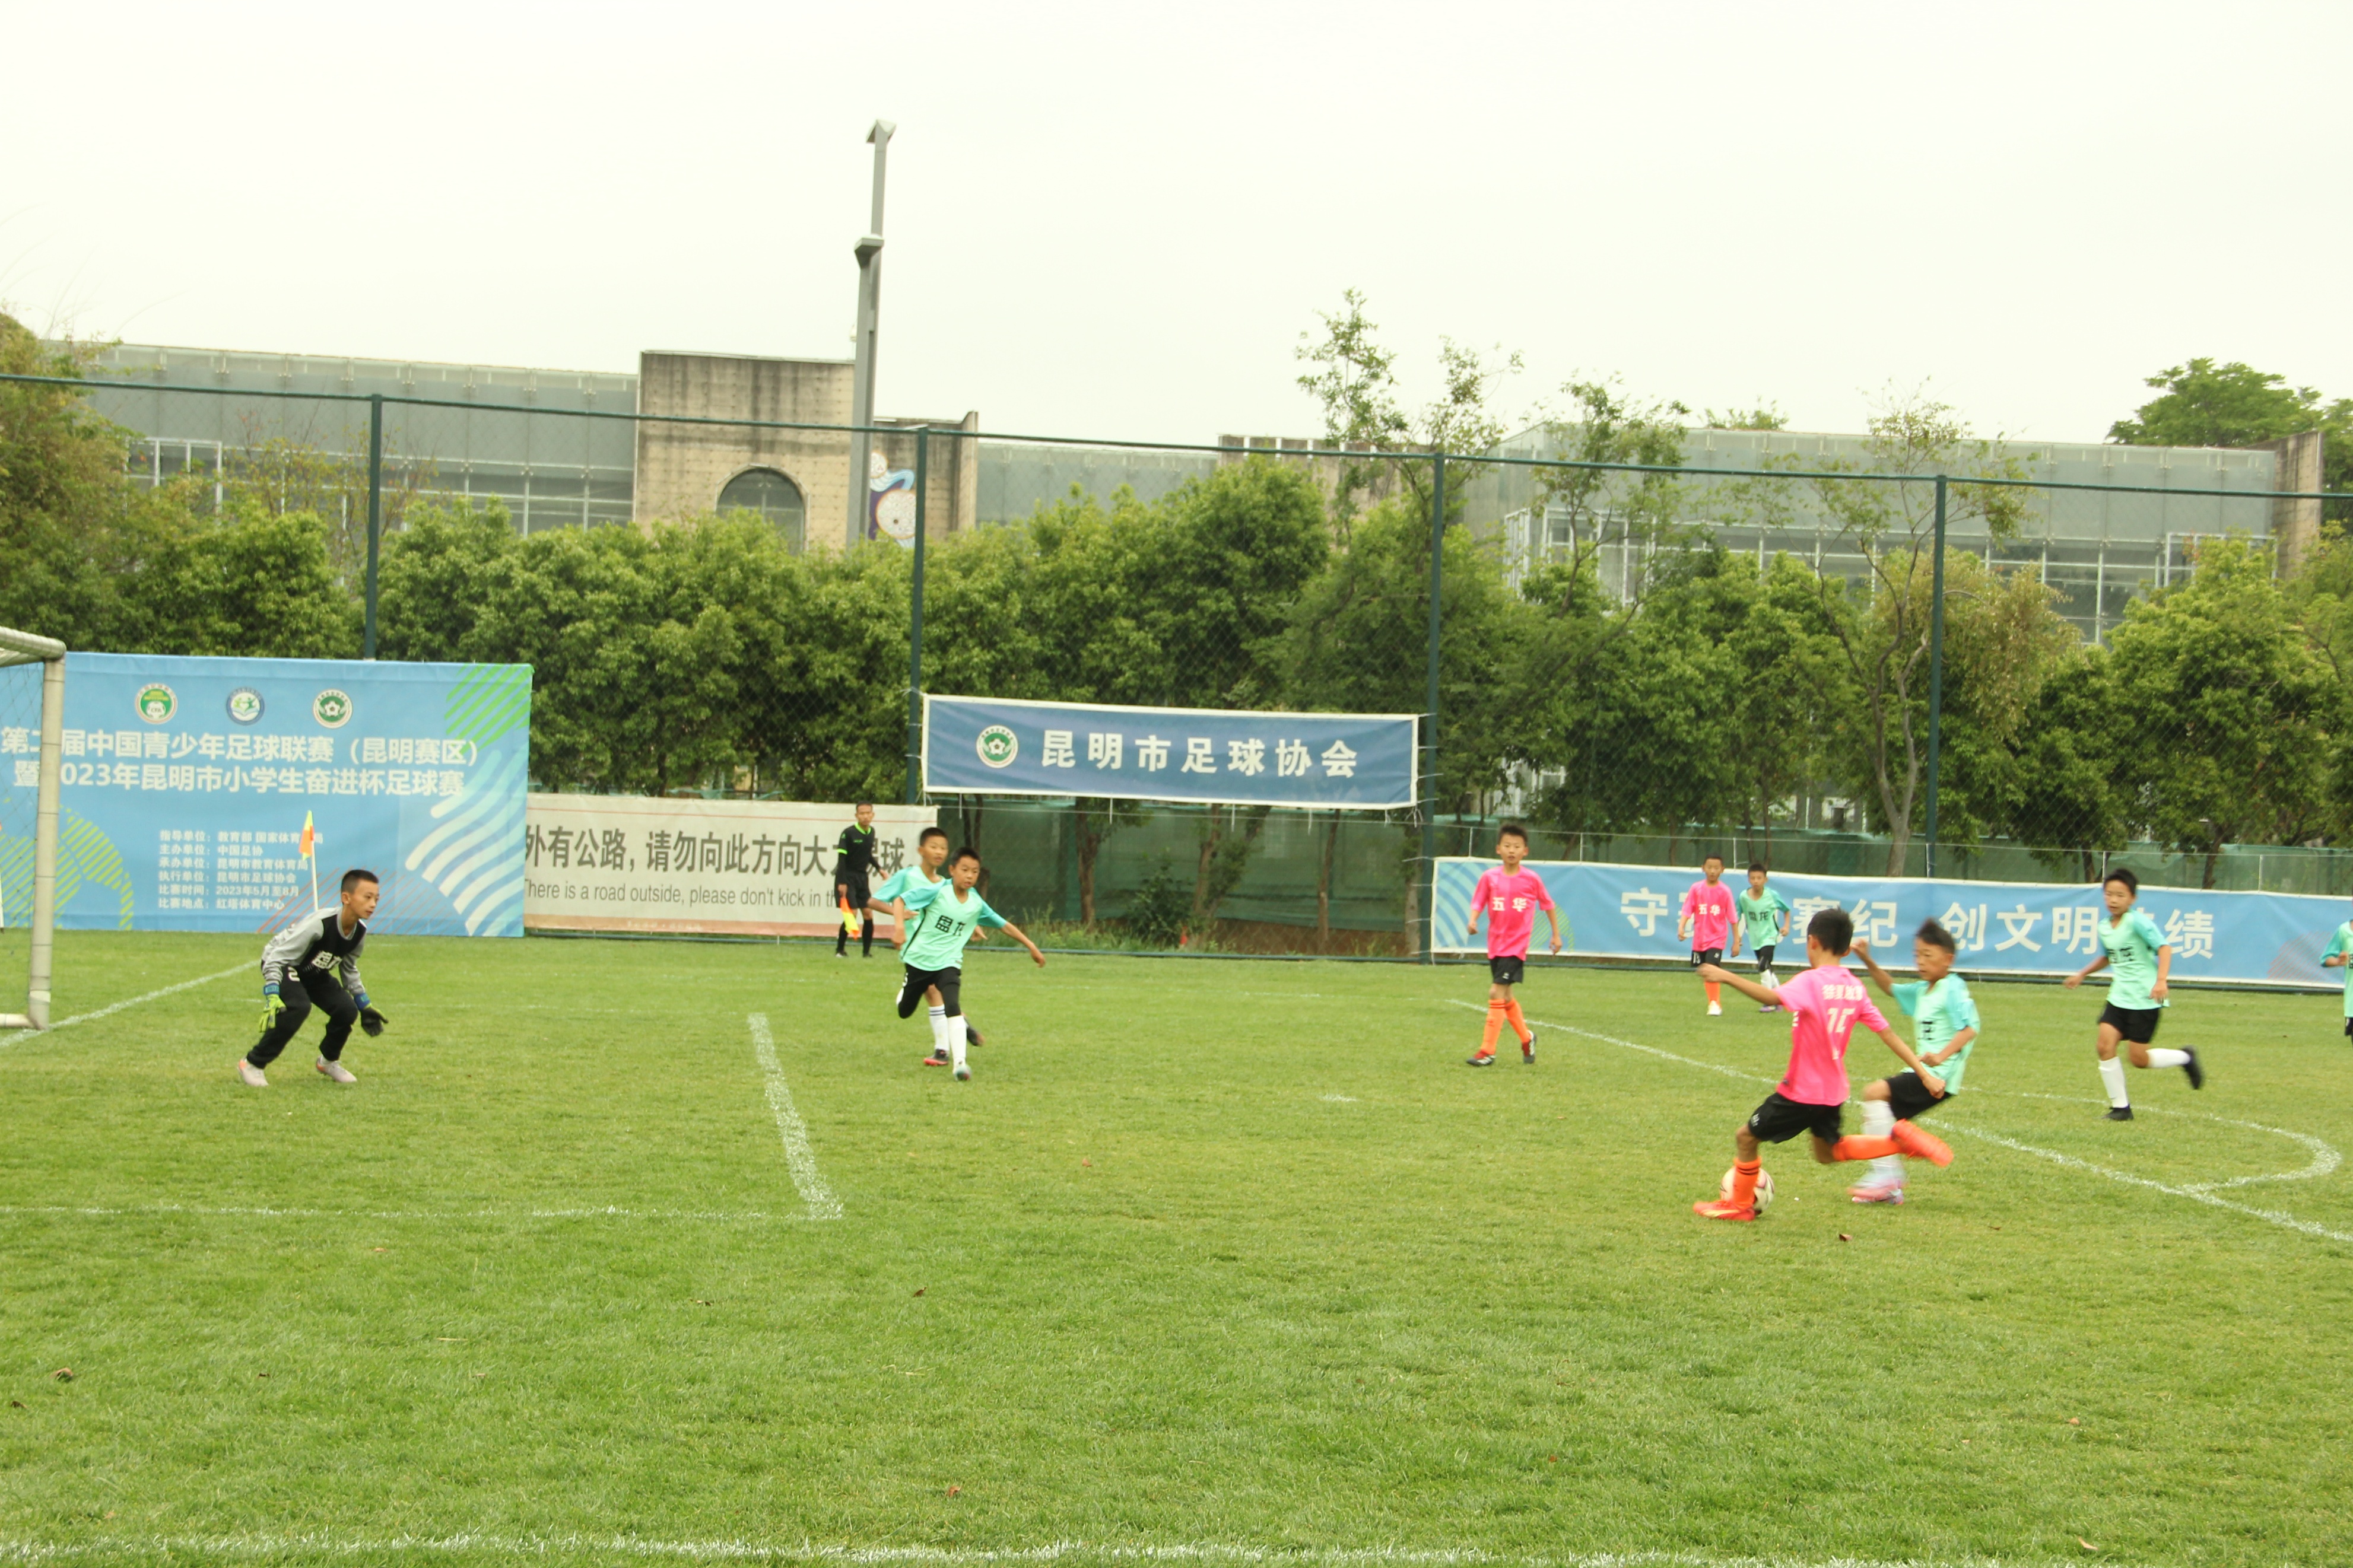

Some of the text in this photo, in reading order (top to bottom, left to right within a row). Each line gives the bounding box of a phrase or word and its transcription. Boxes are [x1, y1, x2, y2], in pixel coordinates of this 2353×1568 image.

[1041, 730, 1357, 778] 昆明市足球协会
[14, 760, 464, 797] 暨023年昆明市小学生奋进杯足球赛
[565, 880, 576, 900] is
[581, 885, 589, 901] a
[595, 883, 625, 901] road
[631, 885, 684, 905] outside,
[690, 886, 736, 907] please
[741, 888, 773, 906] don't
[779, 888, 805, 907] kick
[810, 890, 821, 907] in
[1493, 897, 1527, 912] 五华
[1698, 904, 1720, 916] 五华
[1939, 902, 2214, 959] 创文明绩
